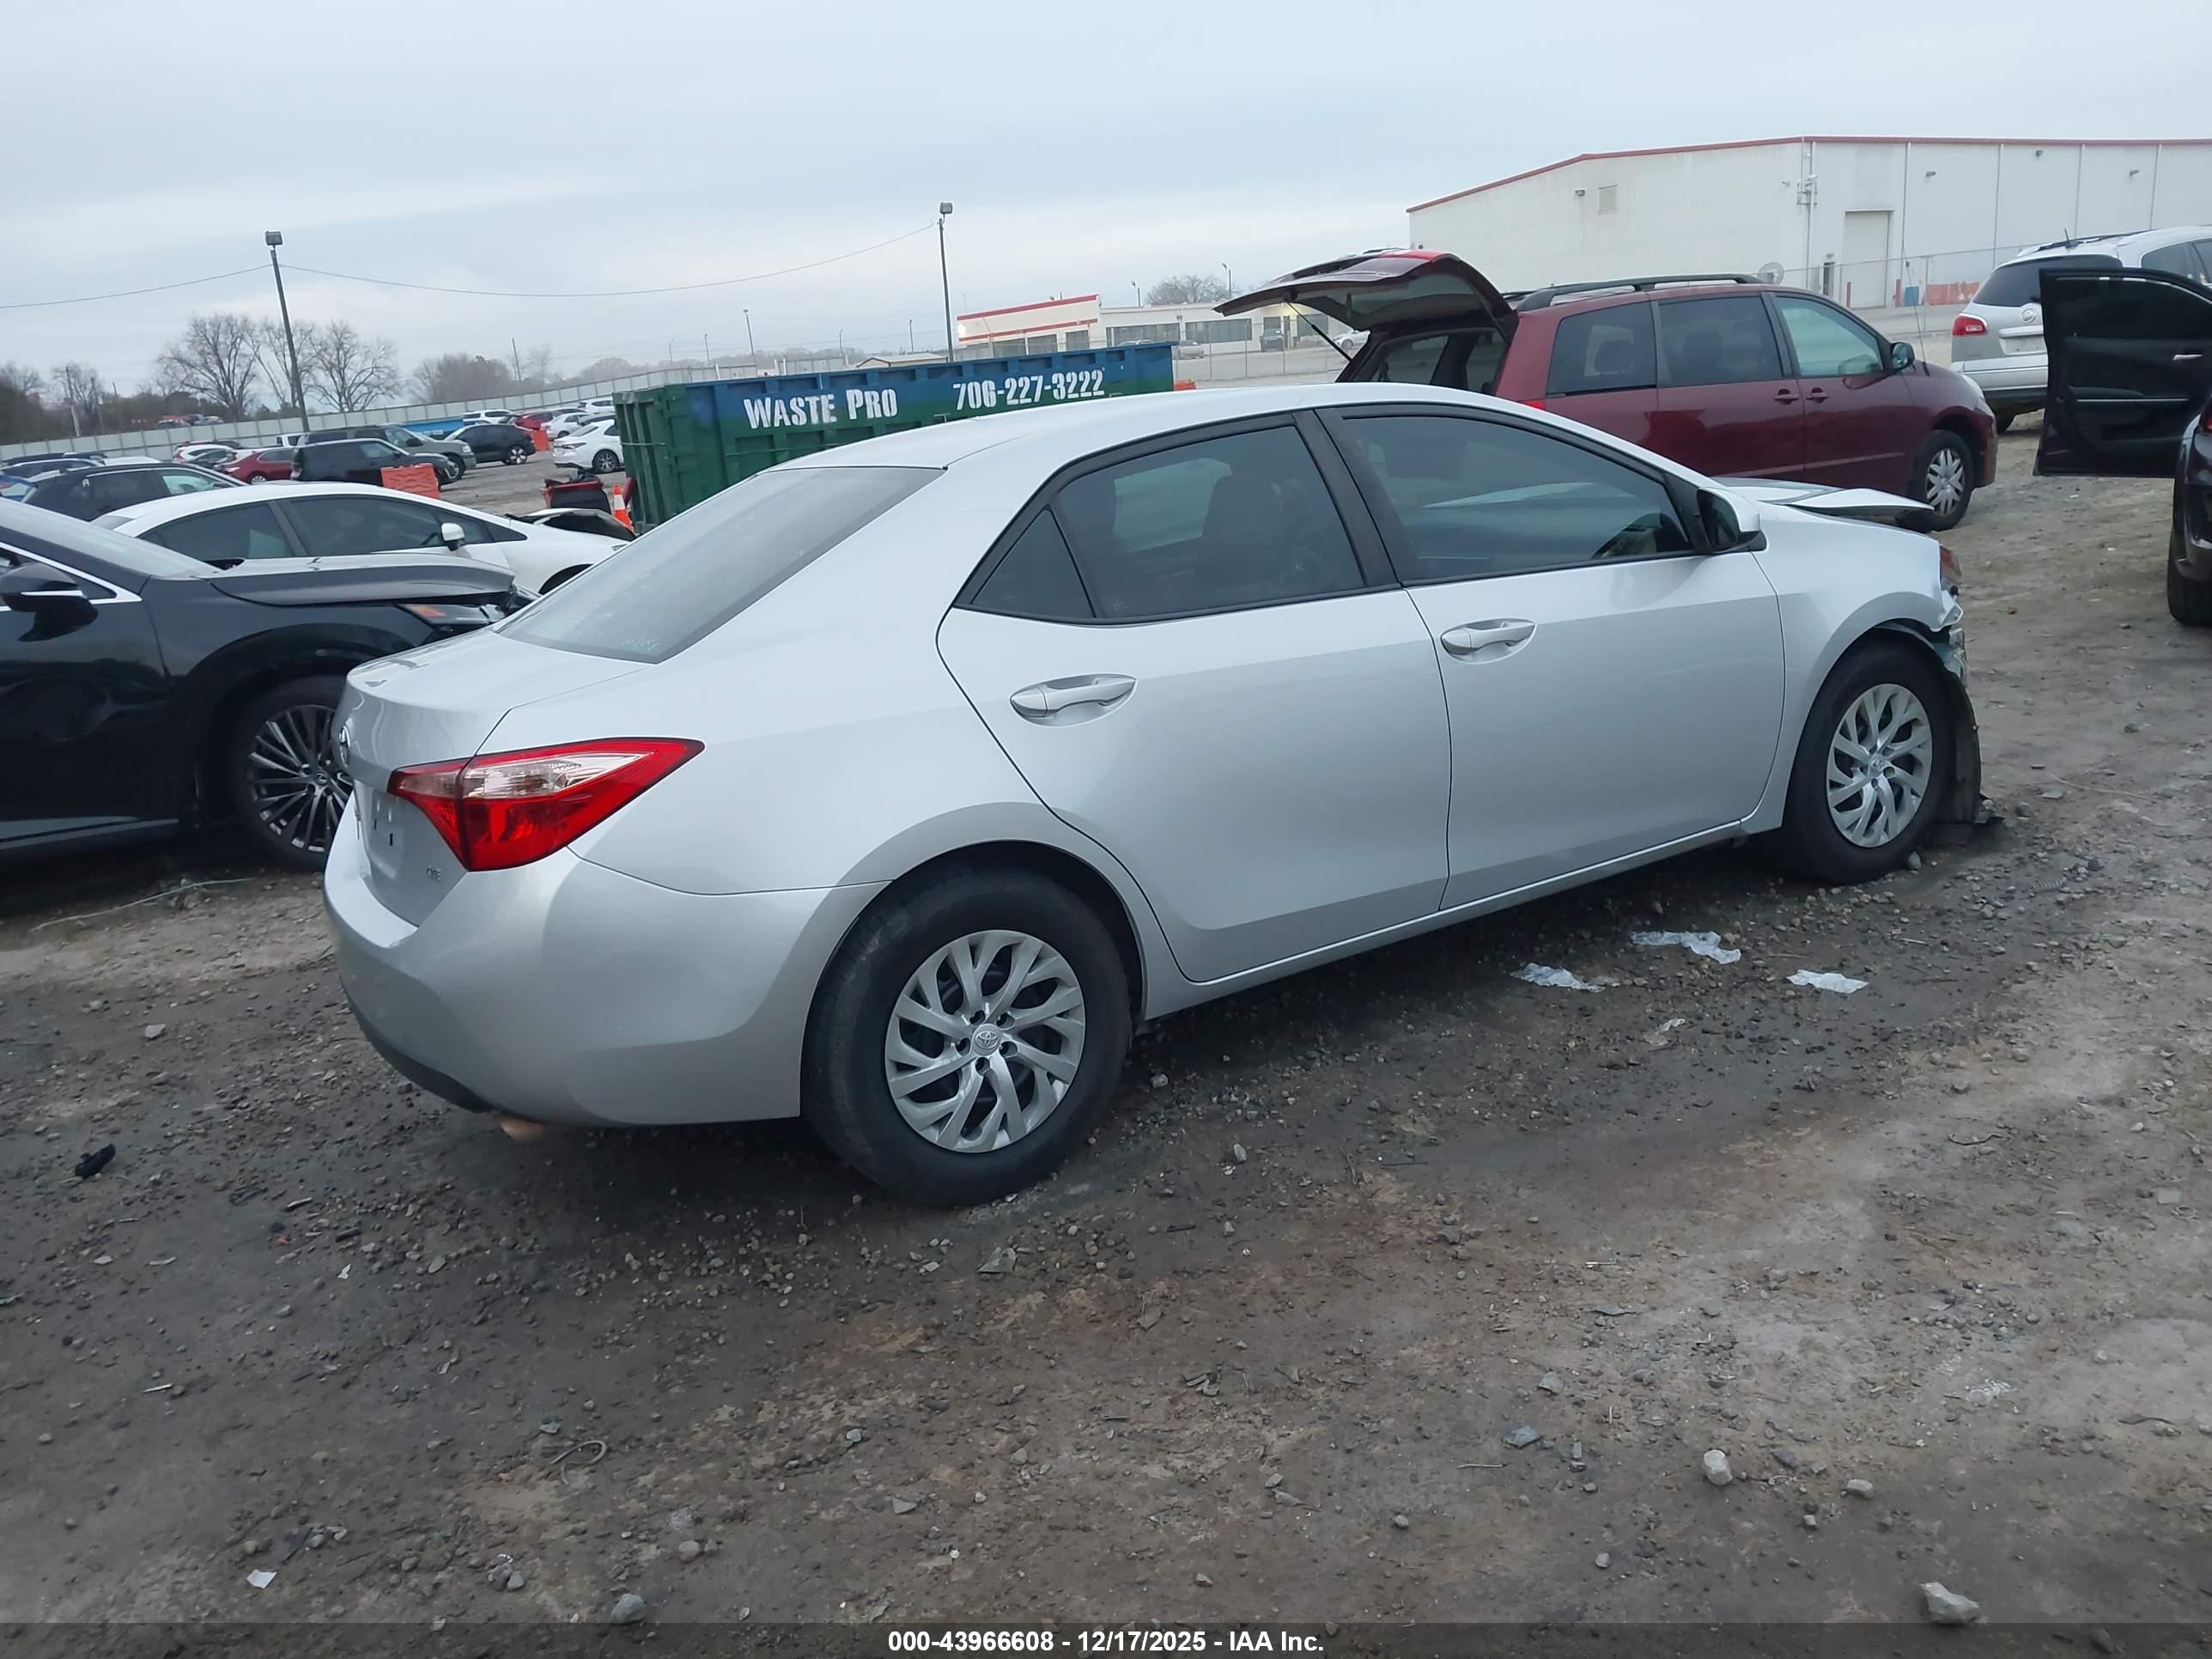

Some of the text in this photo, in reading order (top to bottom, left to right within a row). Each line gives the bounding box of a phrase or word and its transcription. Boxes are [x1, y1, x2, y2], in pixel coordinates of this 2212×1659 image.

[743, 388, 898, 429] WASTE PRO
[952, 368, 1105, 410] 706-227-3222
